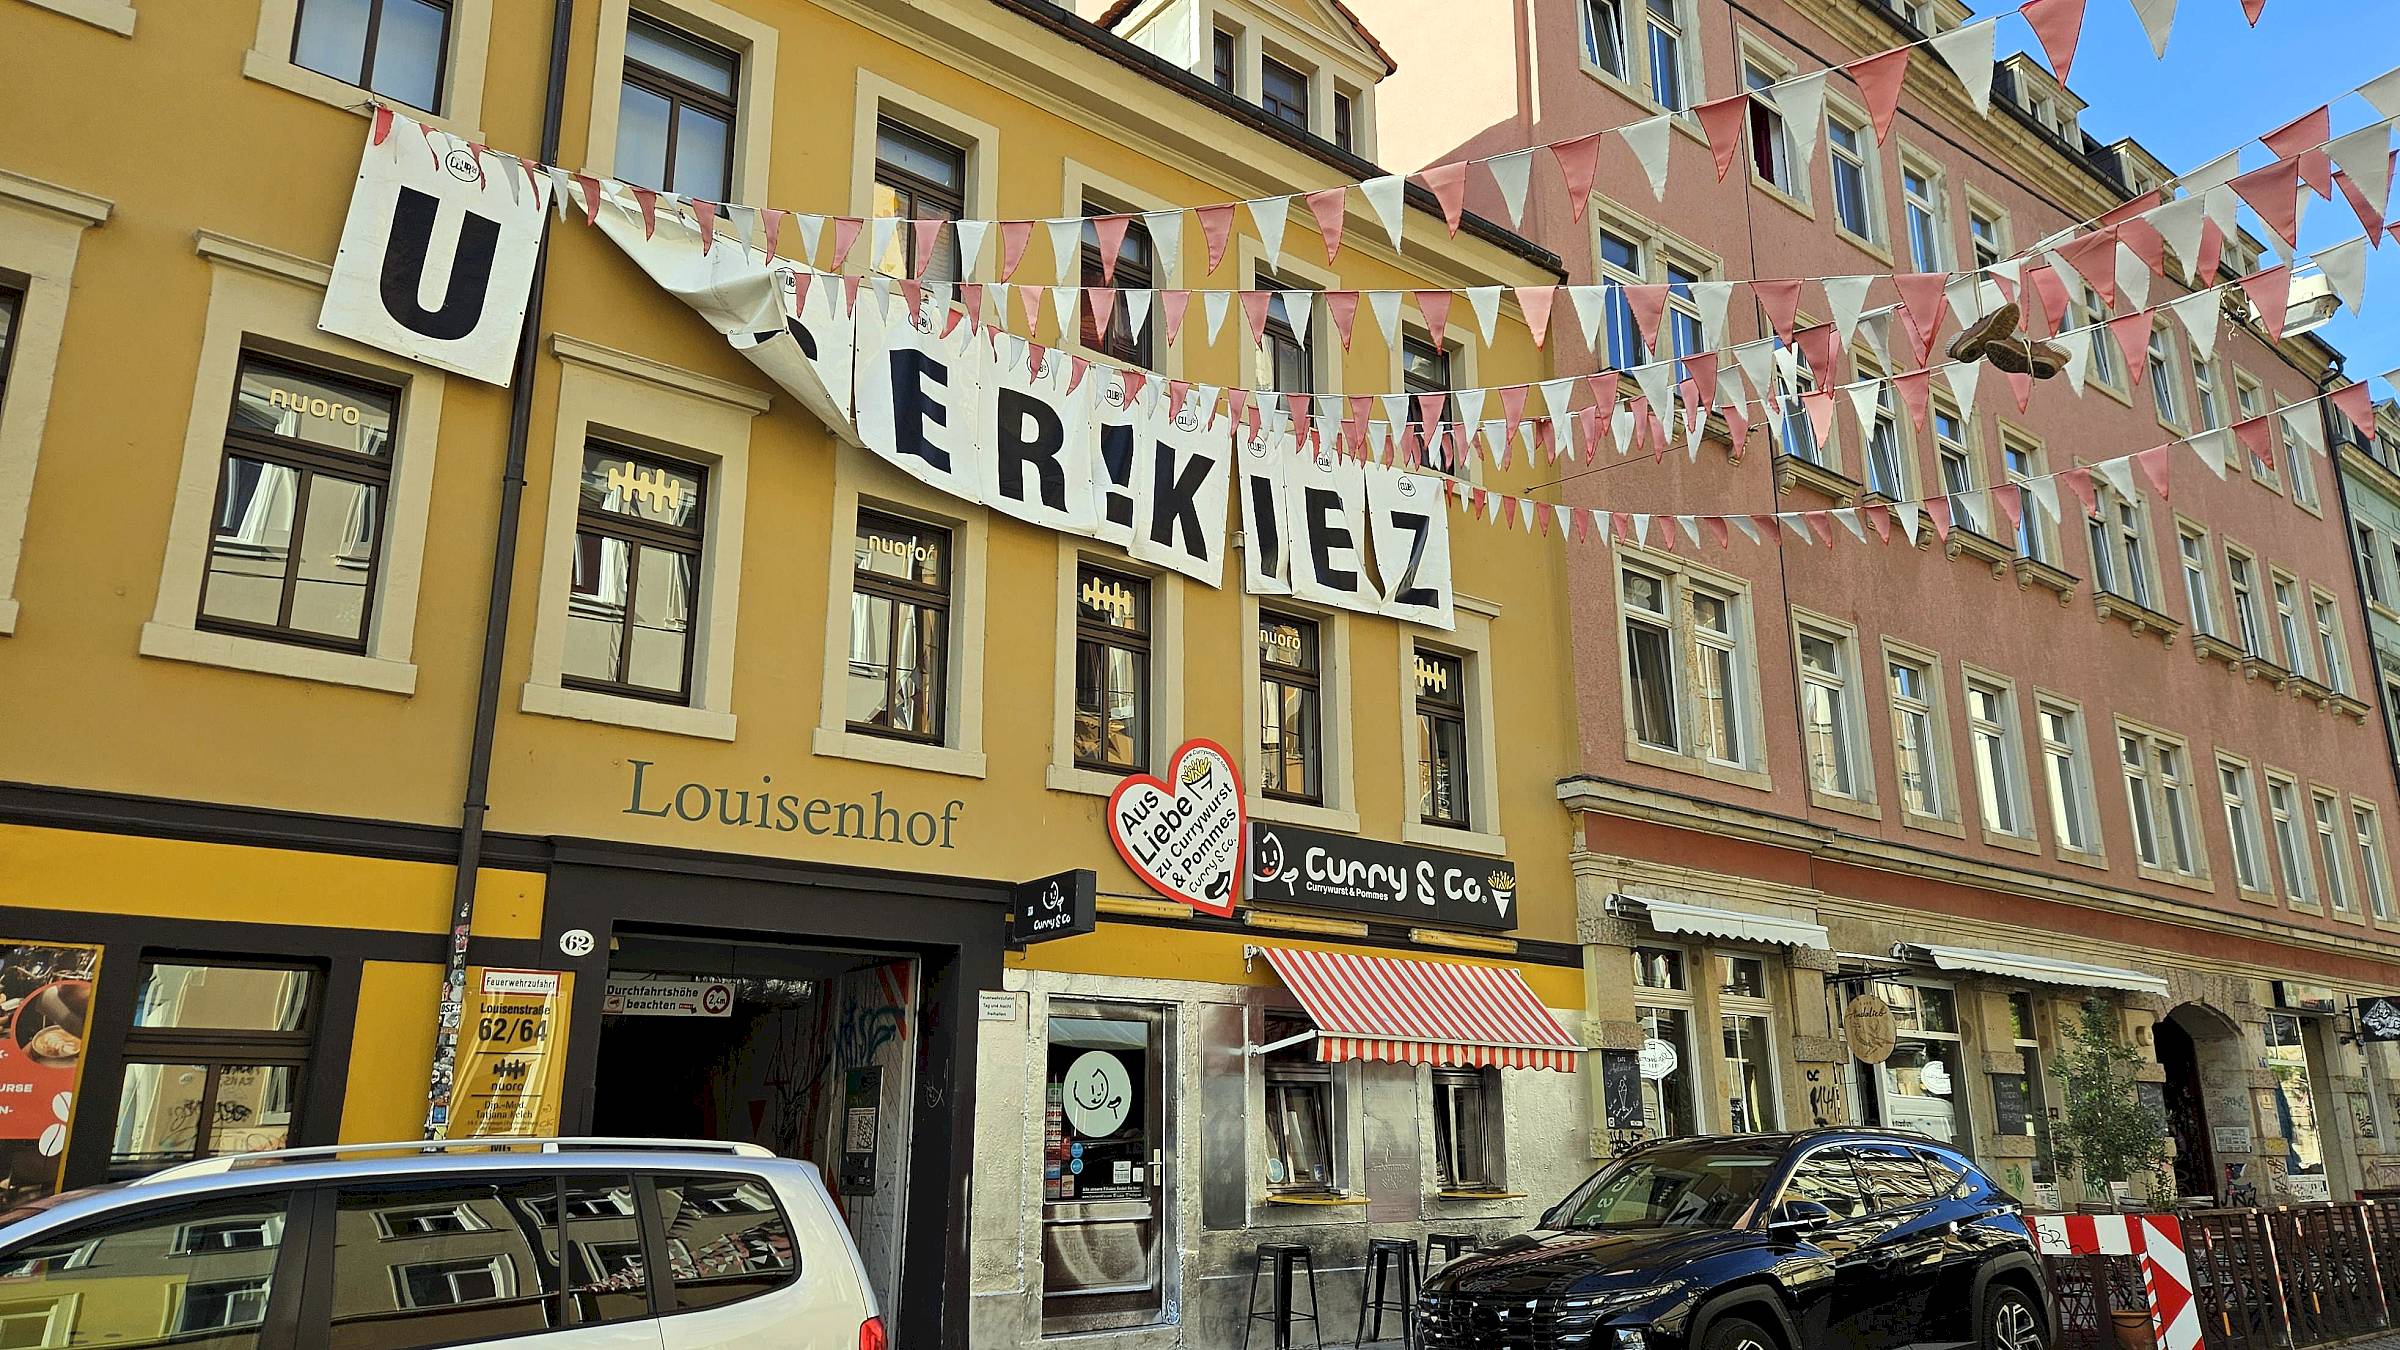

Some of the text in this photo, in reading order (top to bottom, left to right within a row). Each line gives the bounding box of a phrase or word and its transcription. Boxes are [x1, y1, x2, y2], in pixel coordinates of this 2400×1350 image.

[269, 388, 360, 425] nuoro
[868, 535, 928, 562] nuoro
[1259, 629, 1301, 650] nuoro
[622, 758, 964, 849] Louisenhof
[1120, 790, 1159, 837] Aus
[1131, 796, 1193, 867] Liebe
[1155, 782, 1233, 879] zu Currywurst
[1172, 808, 1236, 888] & Pommes
[1305, 847, 1408, 901] Curry
[1306, 881, 1388, 901] Currywurst & Pommes
[1033, 918, 1056, 931] Curry
[565, 935, 590, 951] 62
[486, 976, 556, 989] Feuerwehrzufahrt
[607, 985, 699, 998] Durchfahrtshöhe
[480, 1003, 551, 1016] Louisenstraße
[626, 999, 676, 1010] beachten
[478, 1017, 548, 1044] 62/64
